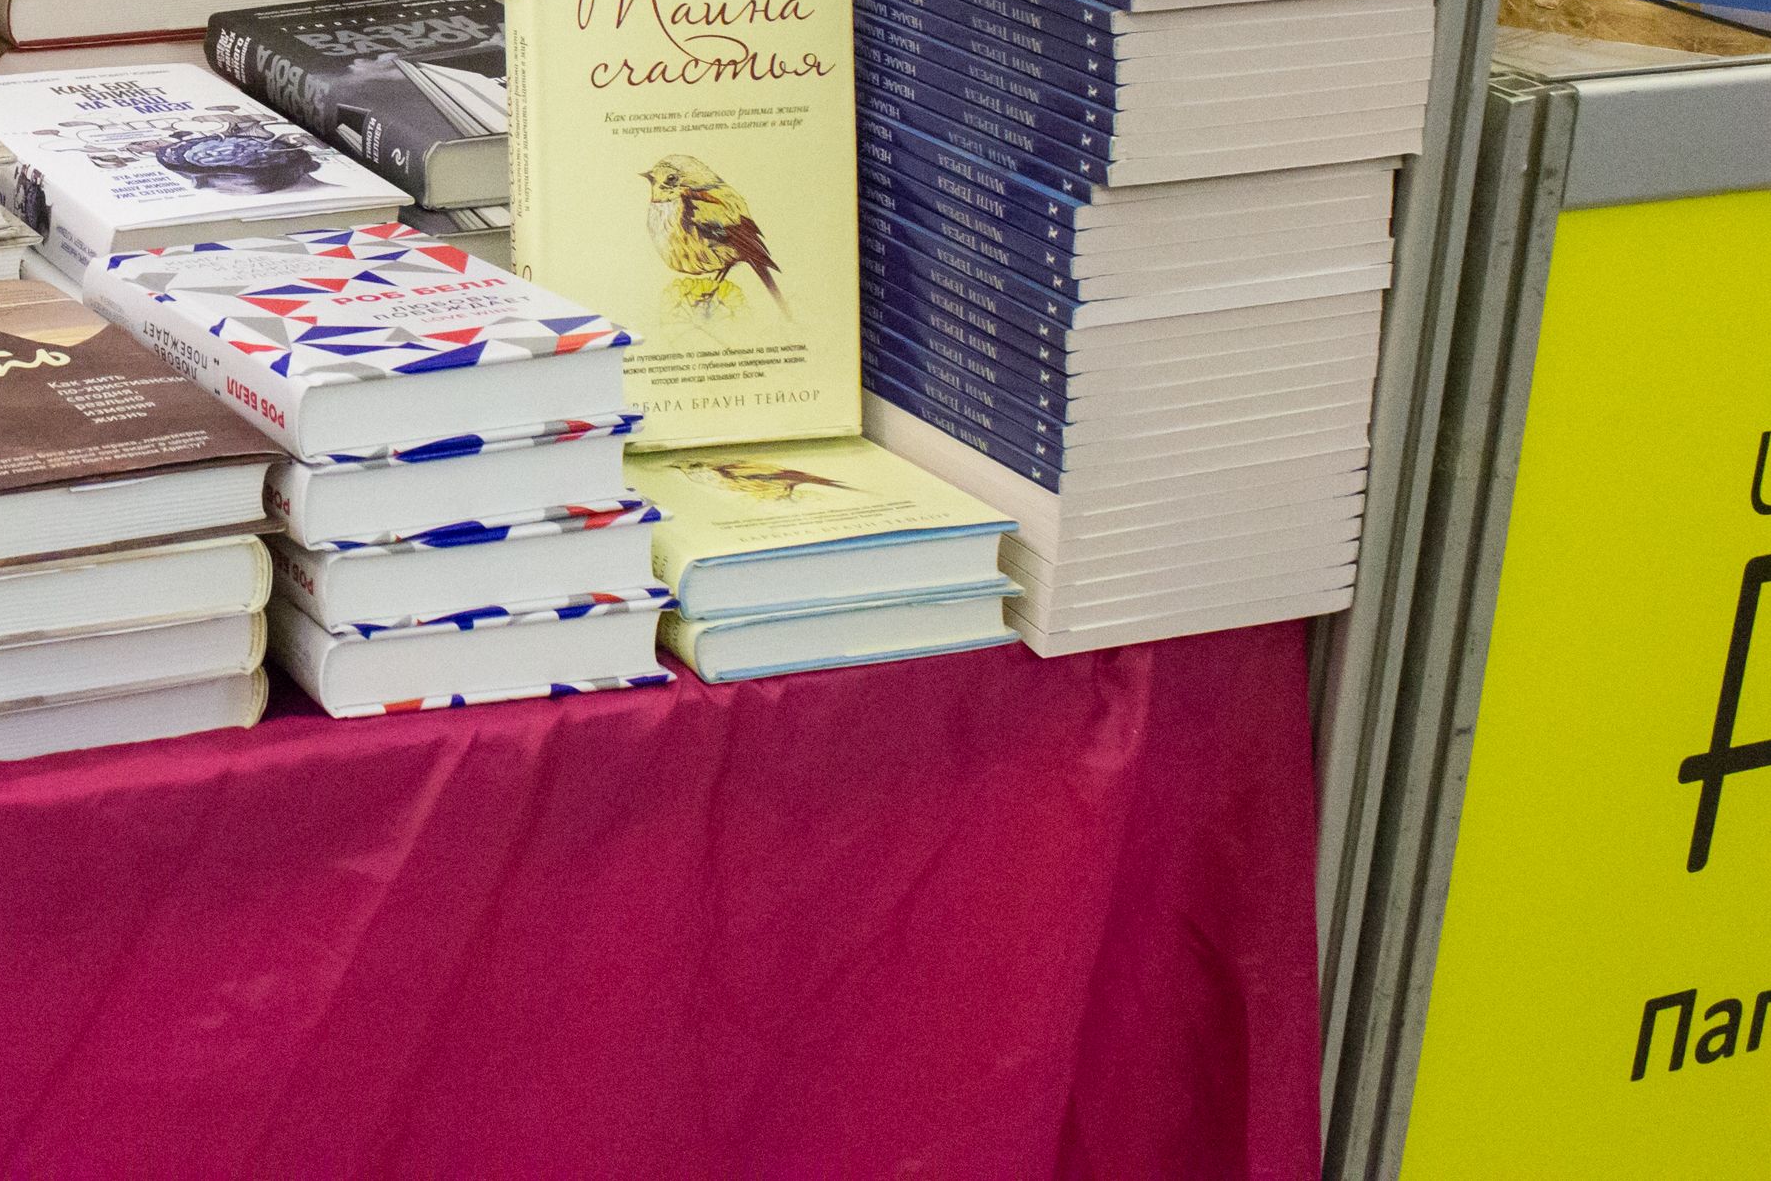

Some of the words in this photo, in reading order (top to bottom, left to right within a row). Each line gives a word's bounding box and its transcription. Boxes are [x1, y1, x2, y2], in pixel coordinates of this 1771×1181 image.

[590, 34, 836, 89] счастья
[49, 83, 98, 96] КАК
[101, 80, 145, 92] БОГ
[81, 86, 168, 101] ВЛИЯЕТ
[75, 100, 113, 111] НА
[112, 96, 169, 108] ВАШ
[133, 100, 195, 115] МОЗГ
[604, 111, 629, 123] Как
[331, 290, 406, 306] РОБ
[411, 277, 508, 297] БЕЛЛ
[372, 295, 531, 321] ПОБЕЖДАЕТ
[391, 294, 500, 312] ЛЮБОВЬ
[46, 378, 81, 389] Как
[691, 395, 746, 410] БРАУН
[754, 389, 822, 406] ТЕЙЛОР
[1630, 988, 1771, 1083] Па
